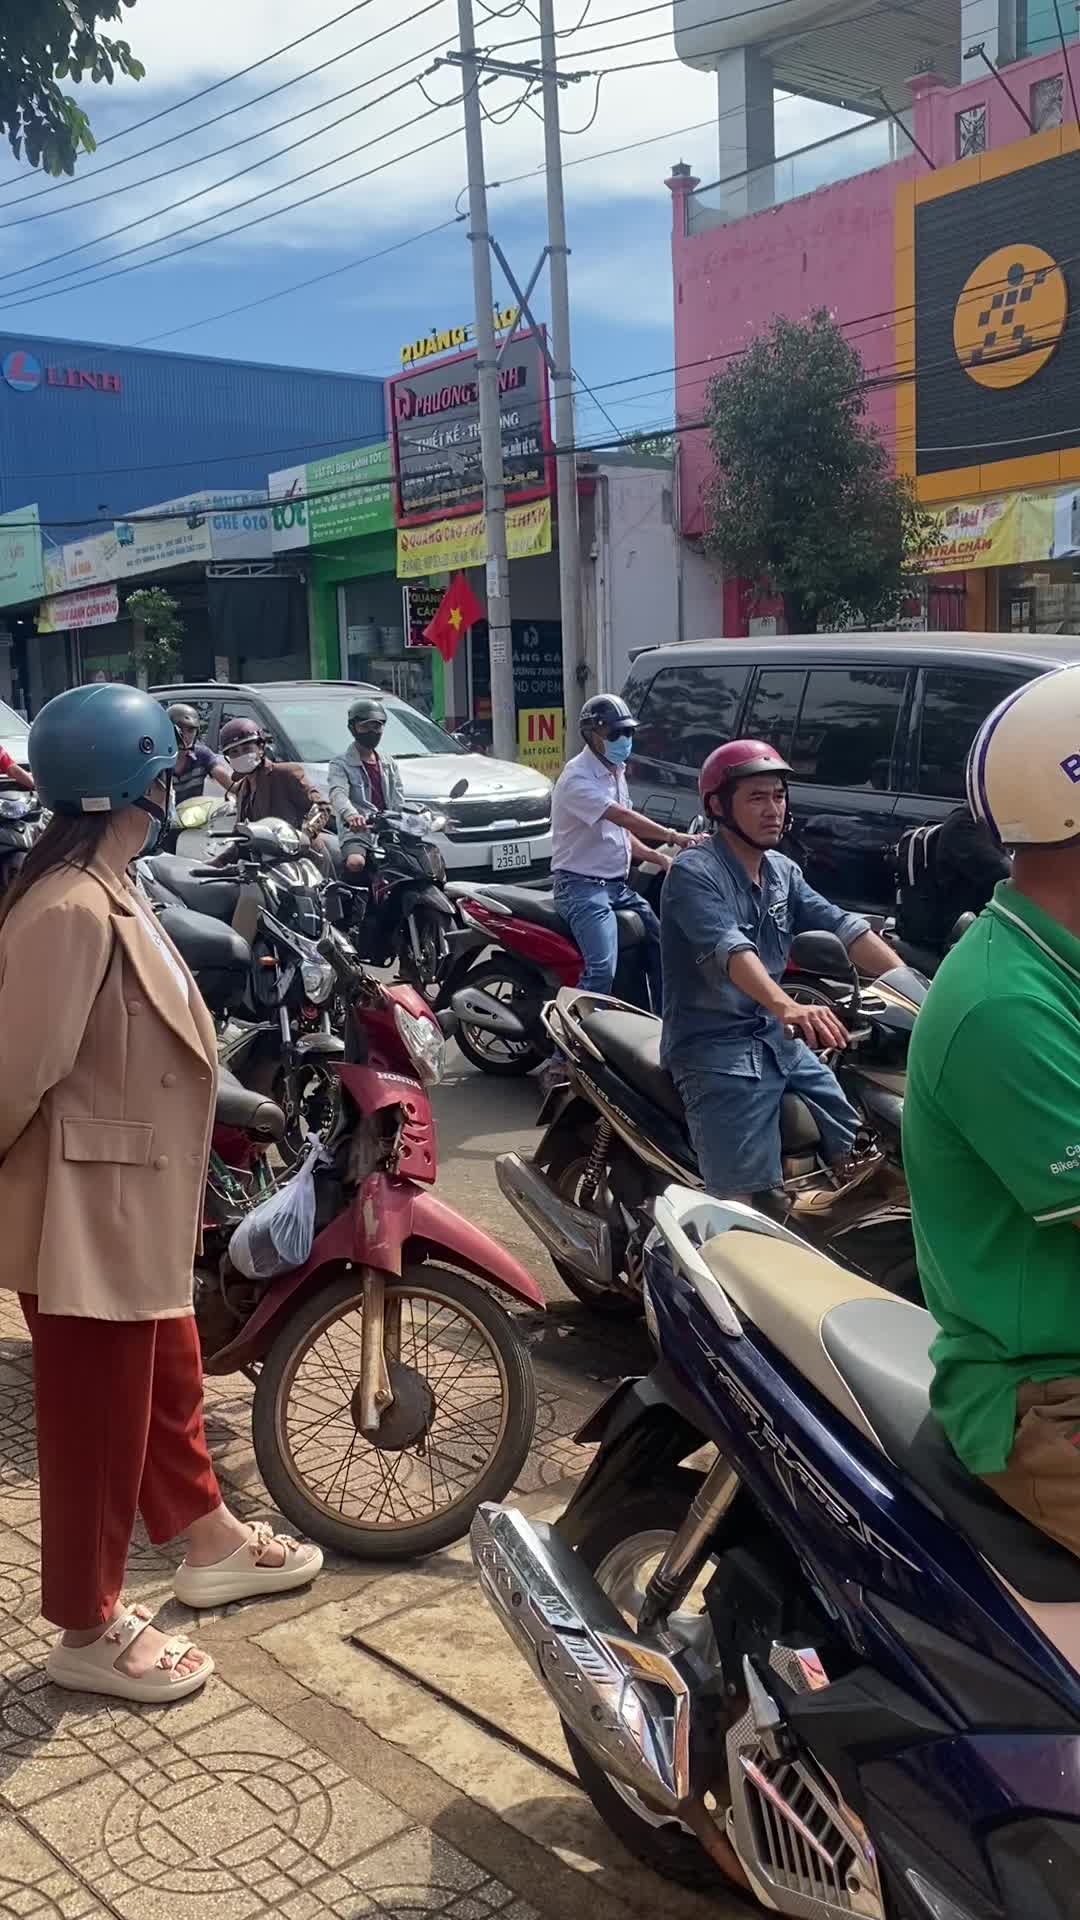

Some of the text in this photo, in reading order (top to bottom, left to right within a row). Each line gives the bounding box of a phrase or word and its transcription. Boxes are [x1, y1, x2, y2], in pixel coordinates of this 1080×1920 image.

[527, 714, 555, 742] IN
[502, 844, 520, 857] 93A
[376, 1070, 422, 1090] HONDA
[1049, 1158, 1080, 1175] Bikes
